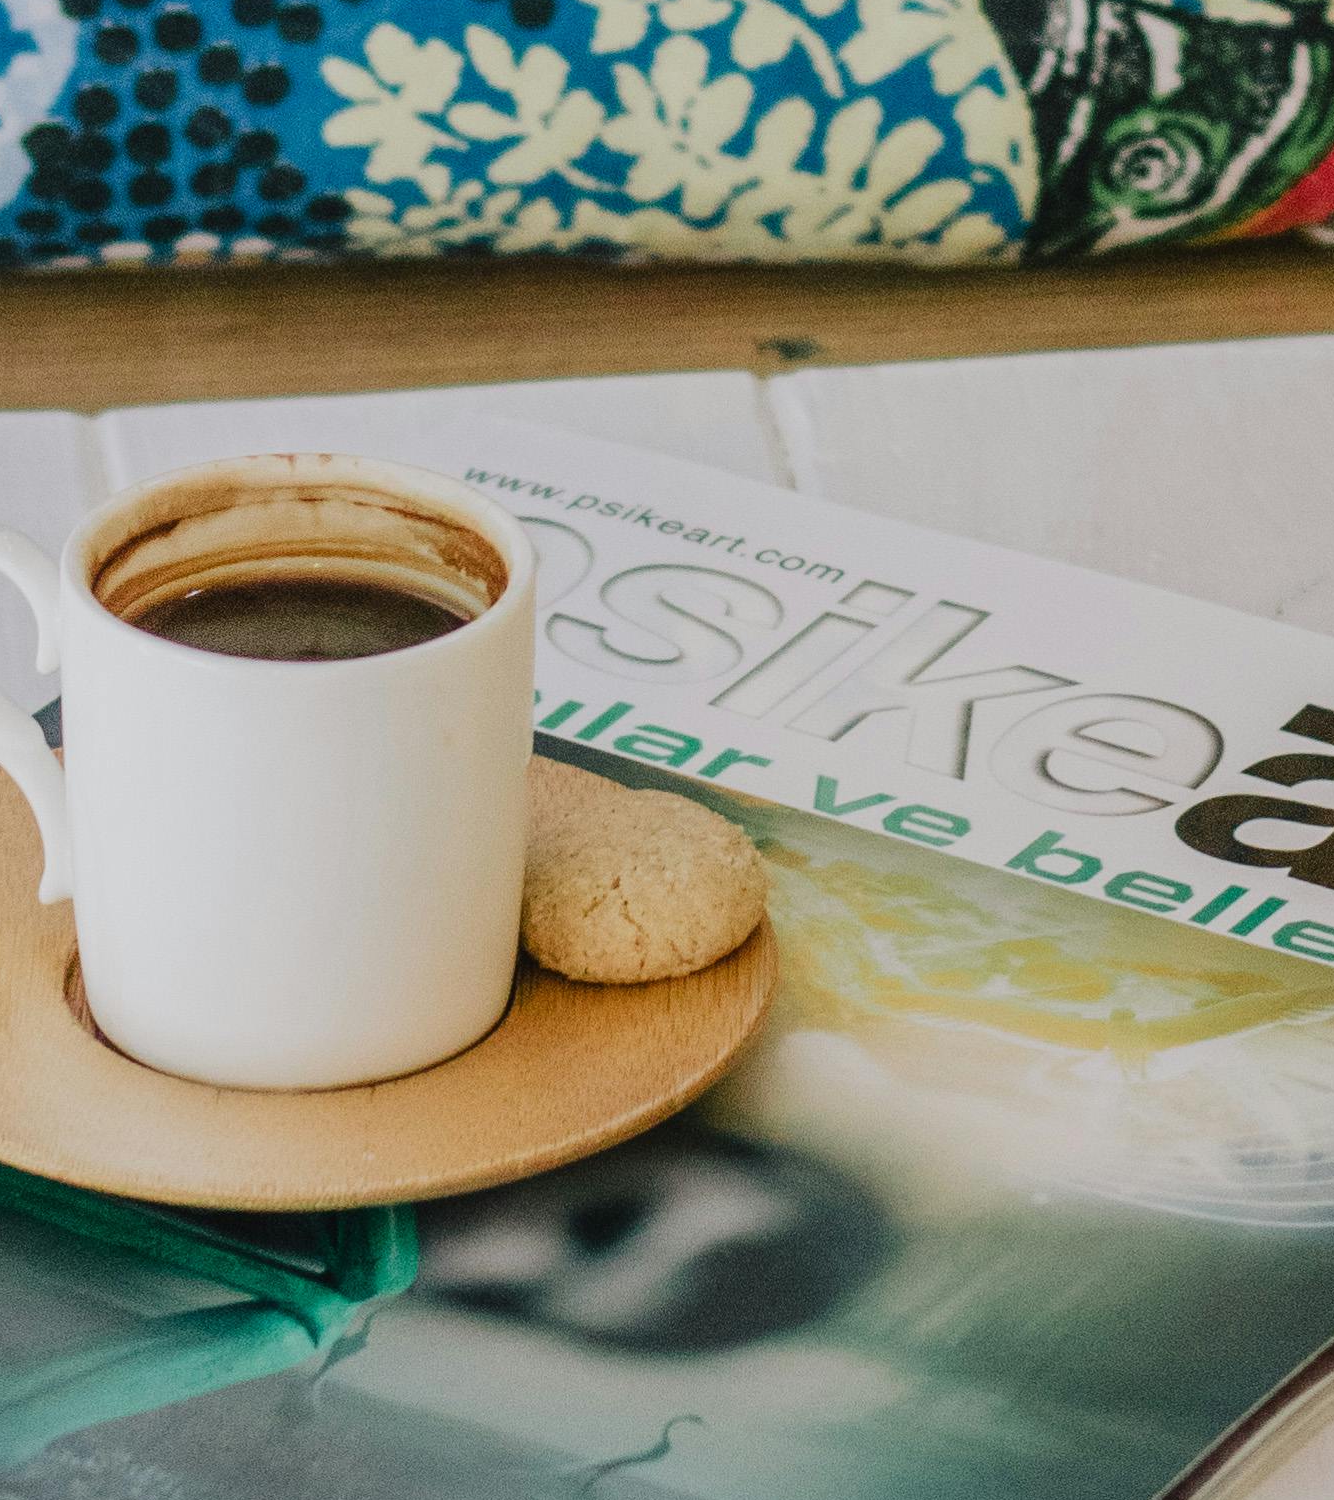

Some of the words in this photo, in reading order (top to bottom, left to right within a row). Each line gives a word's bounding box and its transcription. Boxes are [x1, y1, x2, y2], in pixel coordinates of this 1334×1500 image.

[464, 466, 846, 584] www.psikeart.com
[534, 689, 774, 779] ılar
[813, 774, 972, 848] ve
